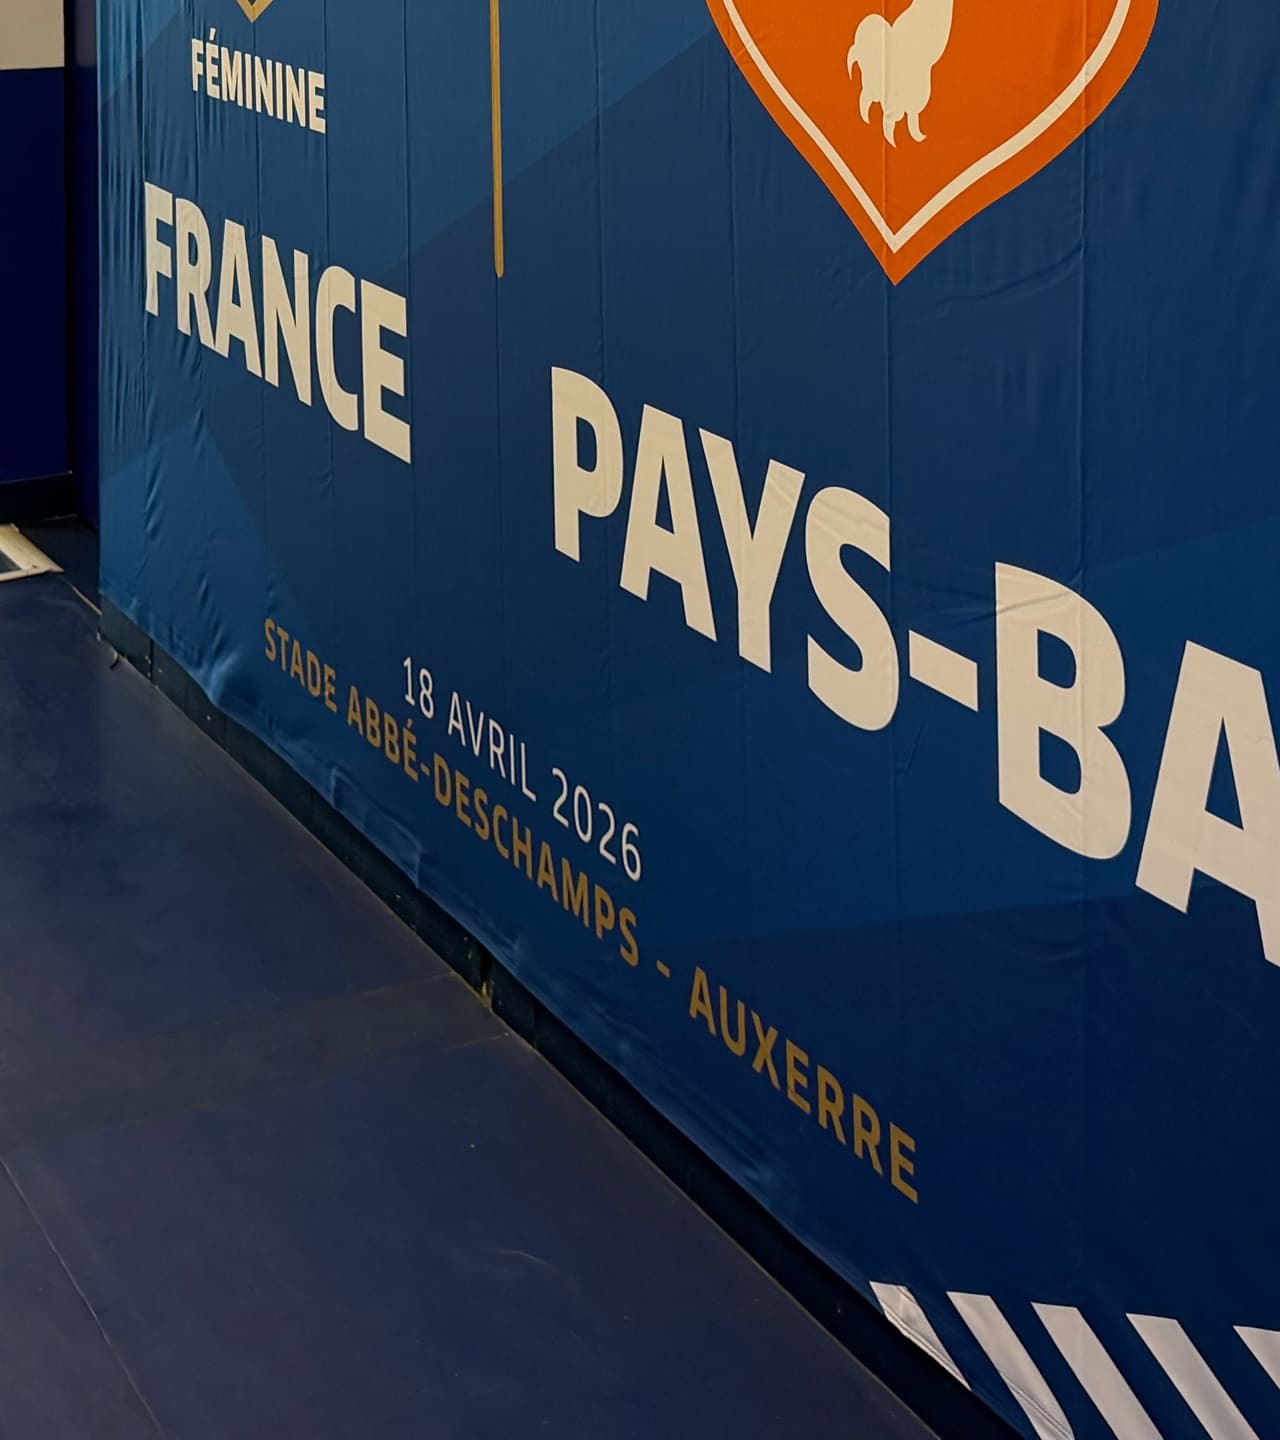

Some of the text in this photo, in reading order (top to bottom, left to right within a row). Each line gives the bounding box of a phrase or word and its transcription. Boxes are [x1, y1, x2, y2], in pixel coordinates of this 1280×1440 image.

[192, 28, 326, 134] FÉMININE
[145, 181, 411, 464] FRANCE
[403, 657, 642, 882] 18 AVRIL 2026
[265, 618, 338, 713] STADE
[347, 685, 639, 967] ABBÉ-DESCHAMPS
[689, 966, 919, 1204] AUXERRE
